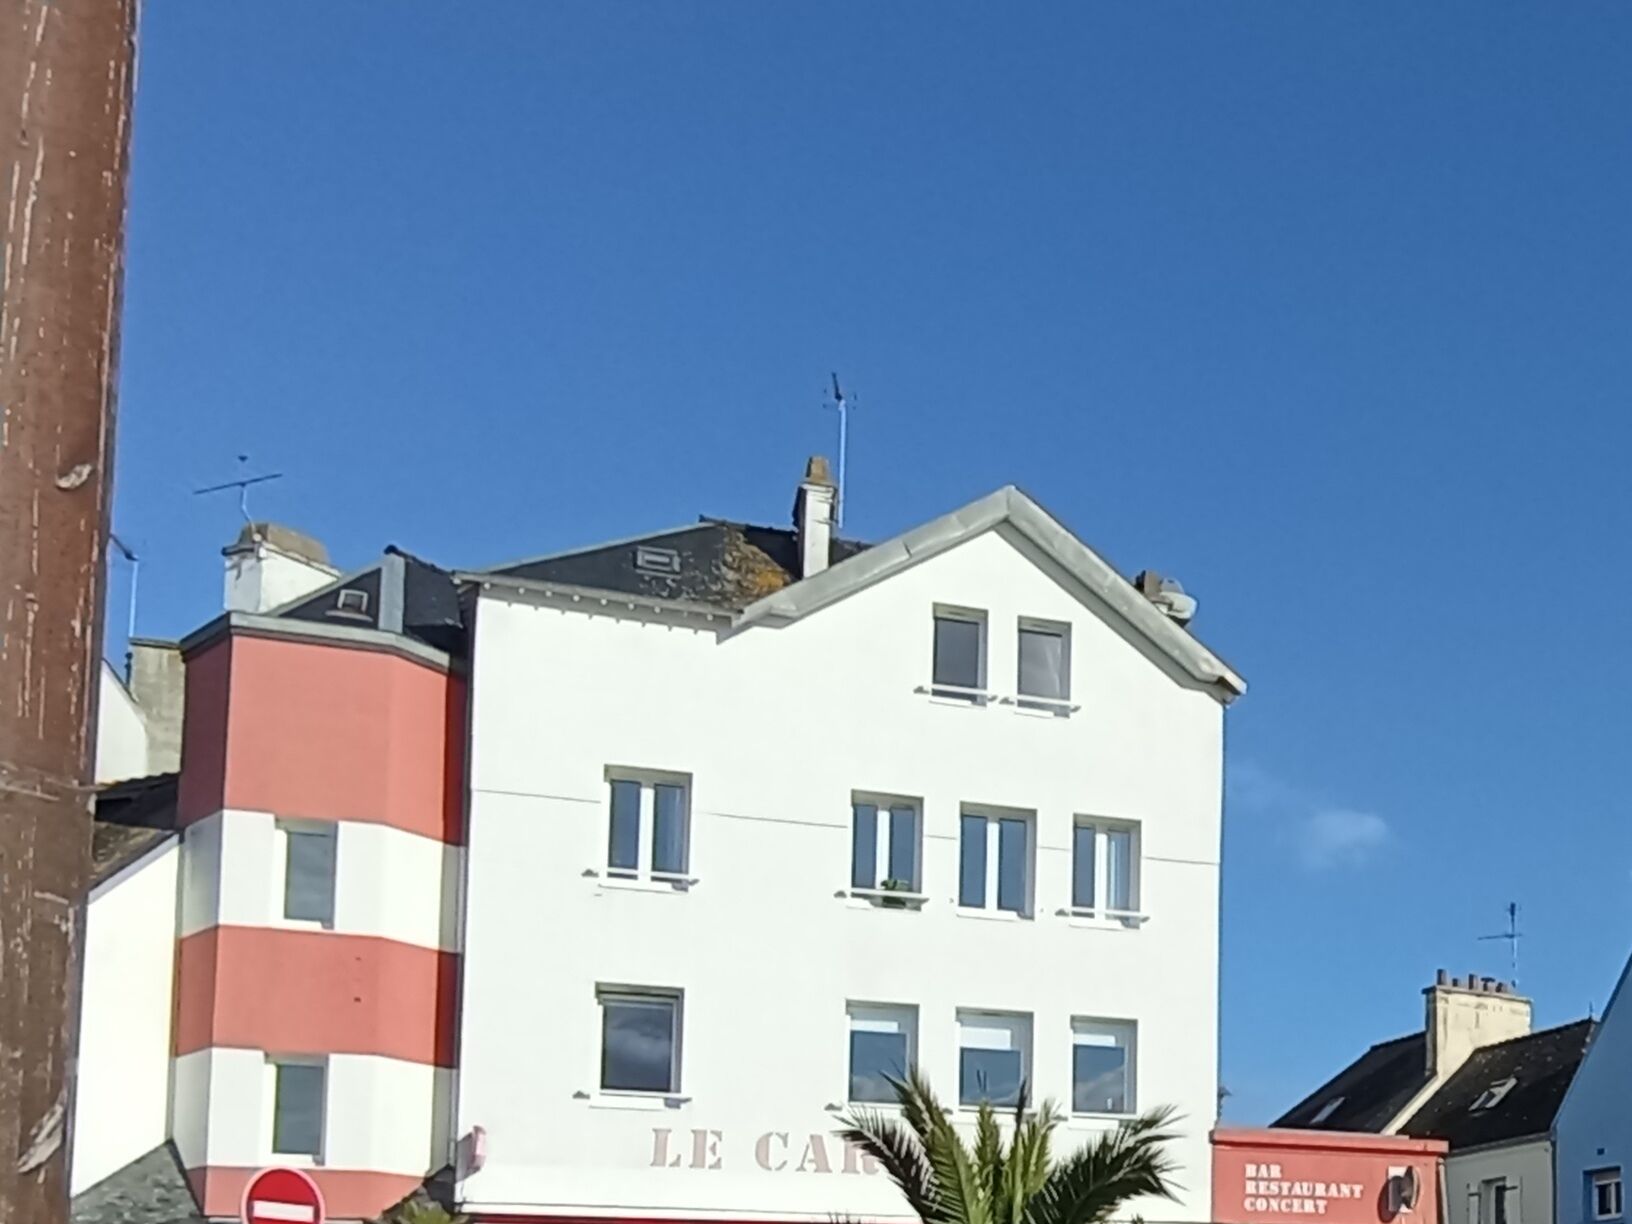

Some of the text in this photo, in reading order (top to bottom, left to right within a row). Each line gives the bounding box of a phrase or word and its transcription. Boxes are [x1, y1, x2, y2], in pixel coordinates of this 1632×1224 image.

[649, 1128, 723, 1170] LE
[1244, 1163, 1282, 1179] BAR
[1244, 1180, 1364, 1199] RESTAURANT
[1243, 1198, 1328, 1214] CONCERT
